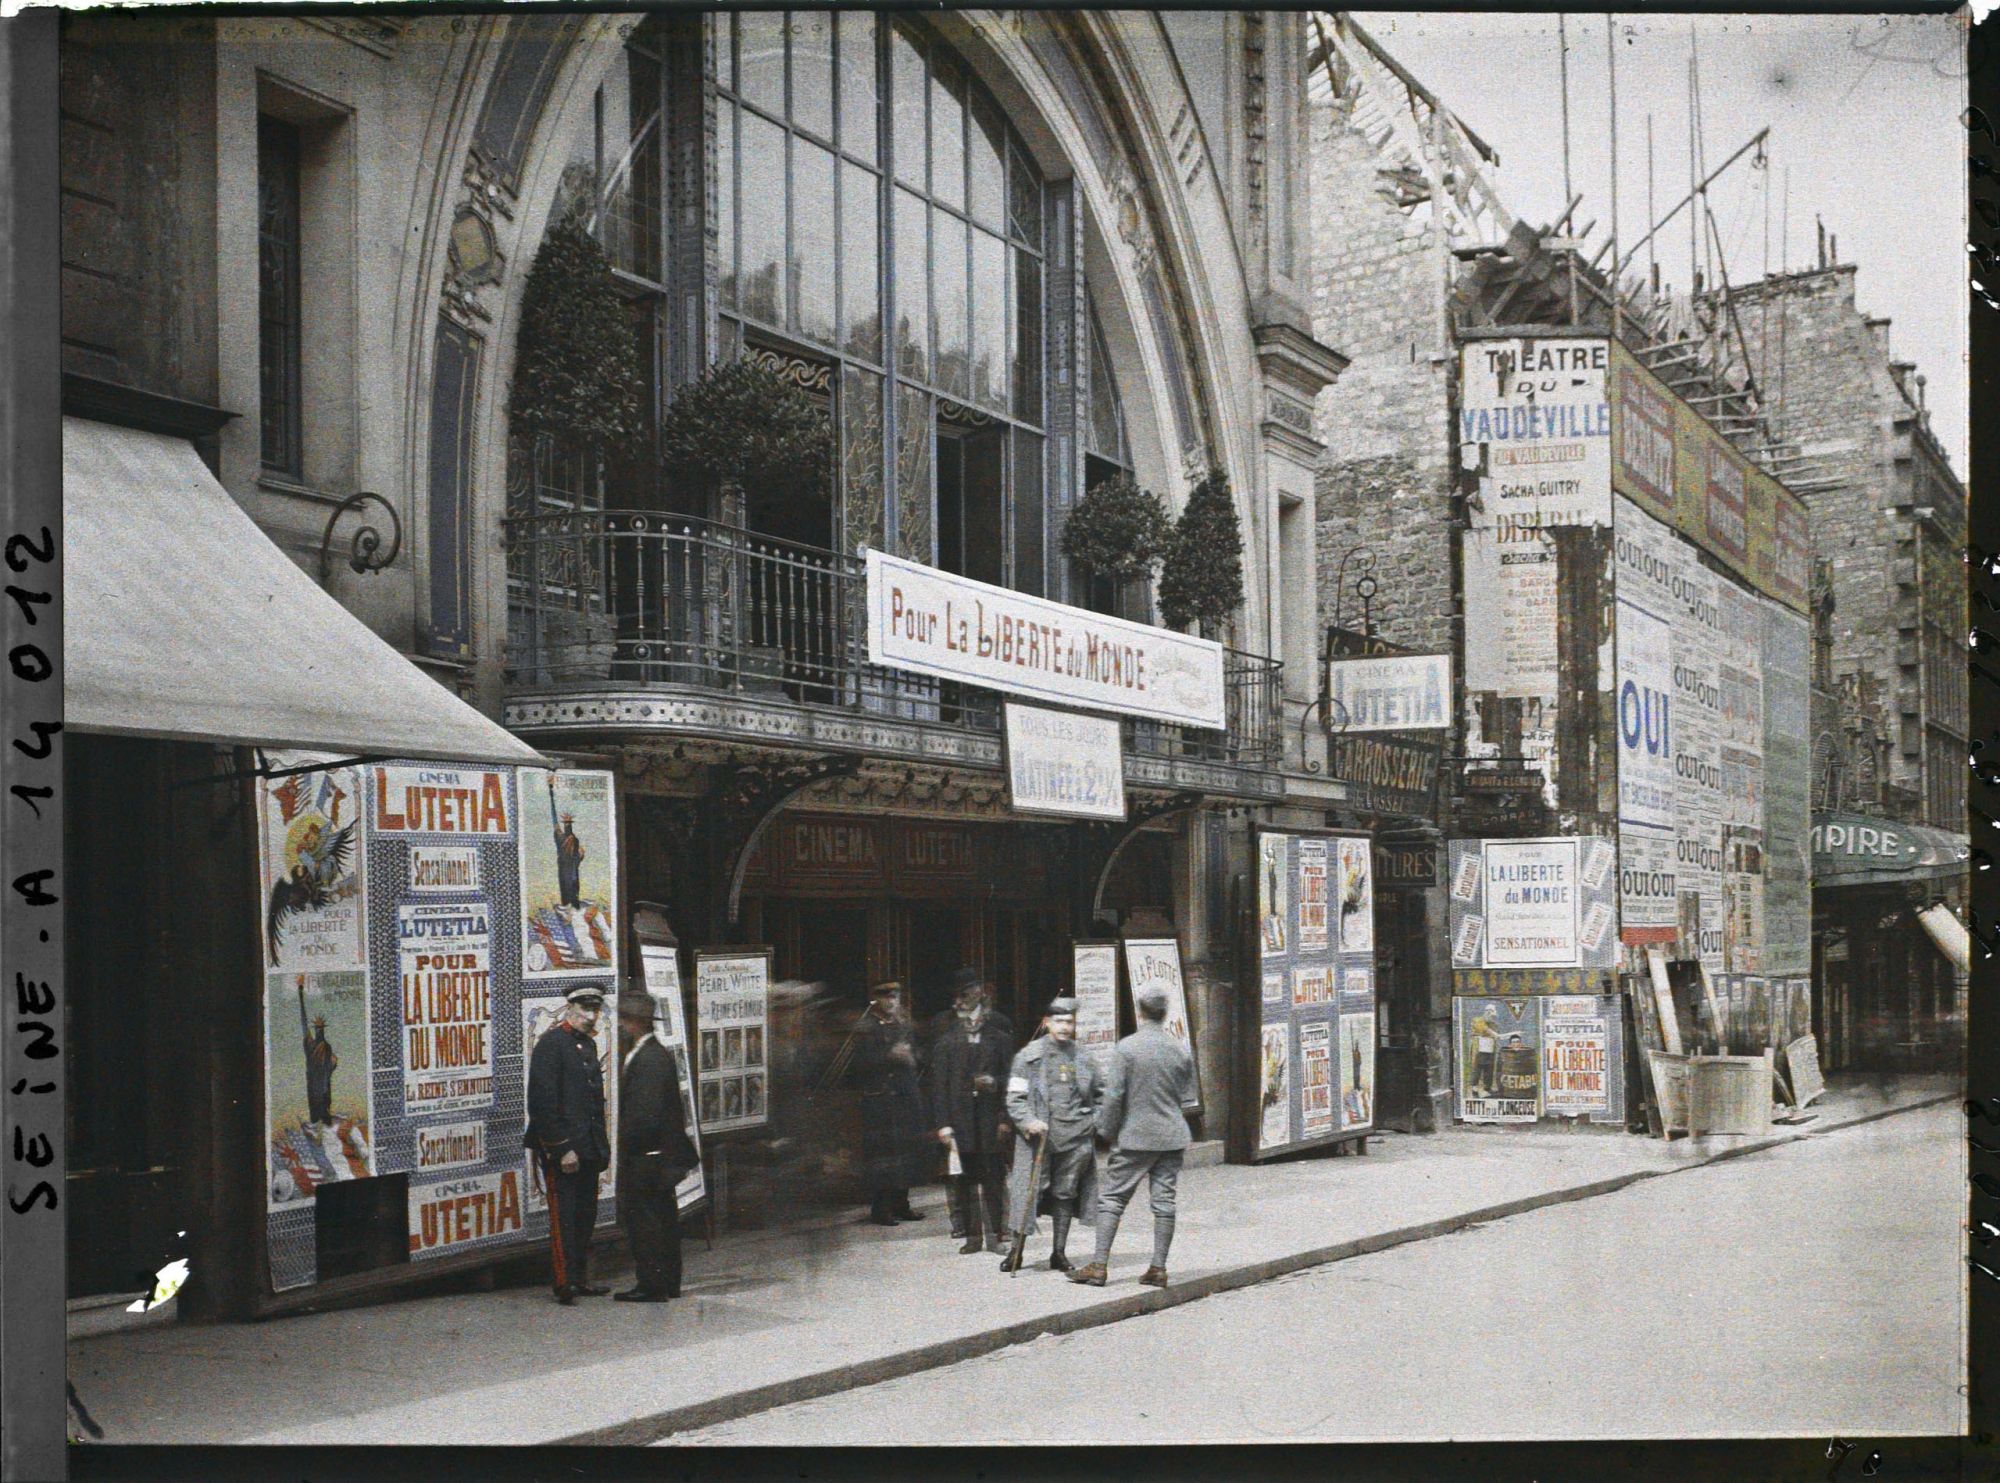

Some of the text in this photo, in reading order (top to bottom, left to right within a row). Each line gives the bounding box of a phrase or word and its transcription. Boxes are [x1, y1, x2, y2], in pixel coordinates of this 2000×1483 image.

[1517, 381, 1557, 393] DU
[1461, 404, 1609, 440] VAUDEVILLE
[1540, 480, 1580, 497] GUITRY
[1617, 537, 1669, 586] OUI OUI
[1672, 576, 1696, 604] OUI
[5, 526, 56, 682] 012
[1696, 600, 1718, 629] OUI
[892, 586, 937, 645] Pour
[946, 600, 967, 653] La
[1067, 638, 1082, 678] du
[1086, 629, 1145, 692] MONDE
[1674, 665, 1697, 692] OUI
[1335, 663, 1443, 726] LUTETIA
[1697, 681, 1719, 710] OUI
[1621, 679, 1669, 758] OUI
[10, 722, 62, 819] 14
[419, 771, 461, 784] CINEMA
[1676, 754, 1698, 779] OUI
[1698, 763, 1720, 790] OUI
[375, 767, 508, 833] LUTETIA
[795, 823, 877, 864] CINEMA
[906, 832, 974, 866] LUTETIA
[1677, 839, 1700, 863] OUI
[1700, 849, 1721, 872] OUI
[1491, 865, 1564, 882] LA LIBERTE
[1622, 870, 1676, 898] OUI OUI
[1506, 887, 1568, 904] du MONDE
[415, 906, 471, 915] CINEMA
[400, 916, 488, 938] LUTETIA
[1494, 937, 1569, 949] SENSATIONNEL
[1701, 930, 1723, 953] OUI
[416, 954, 477, 970] POUR
[403, 969, 491, 1025] LA LIBERTE
[699, 976, 729, 994] PEARL
[1292, 966, 1333, 1004] LUTETIA
[1546, 1025, 1604, 1033] LUTETIA
[409, 1023, 487, 1071] DU MONDE
[1547, 1048, 1605, 1071] LA LIBERTE
[418, 1081, 447, 1101] REINE
[1550, 1072, 1602, 1091] DU MONDE
[1465, 1101, 1485, 1116] FATTY
